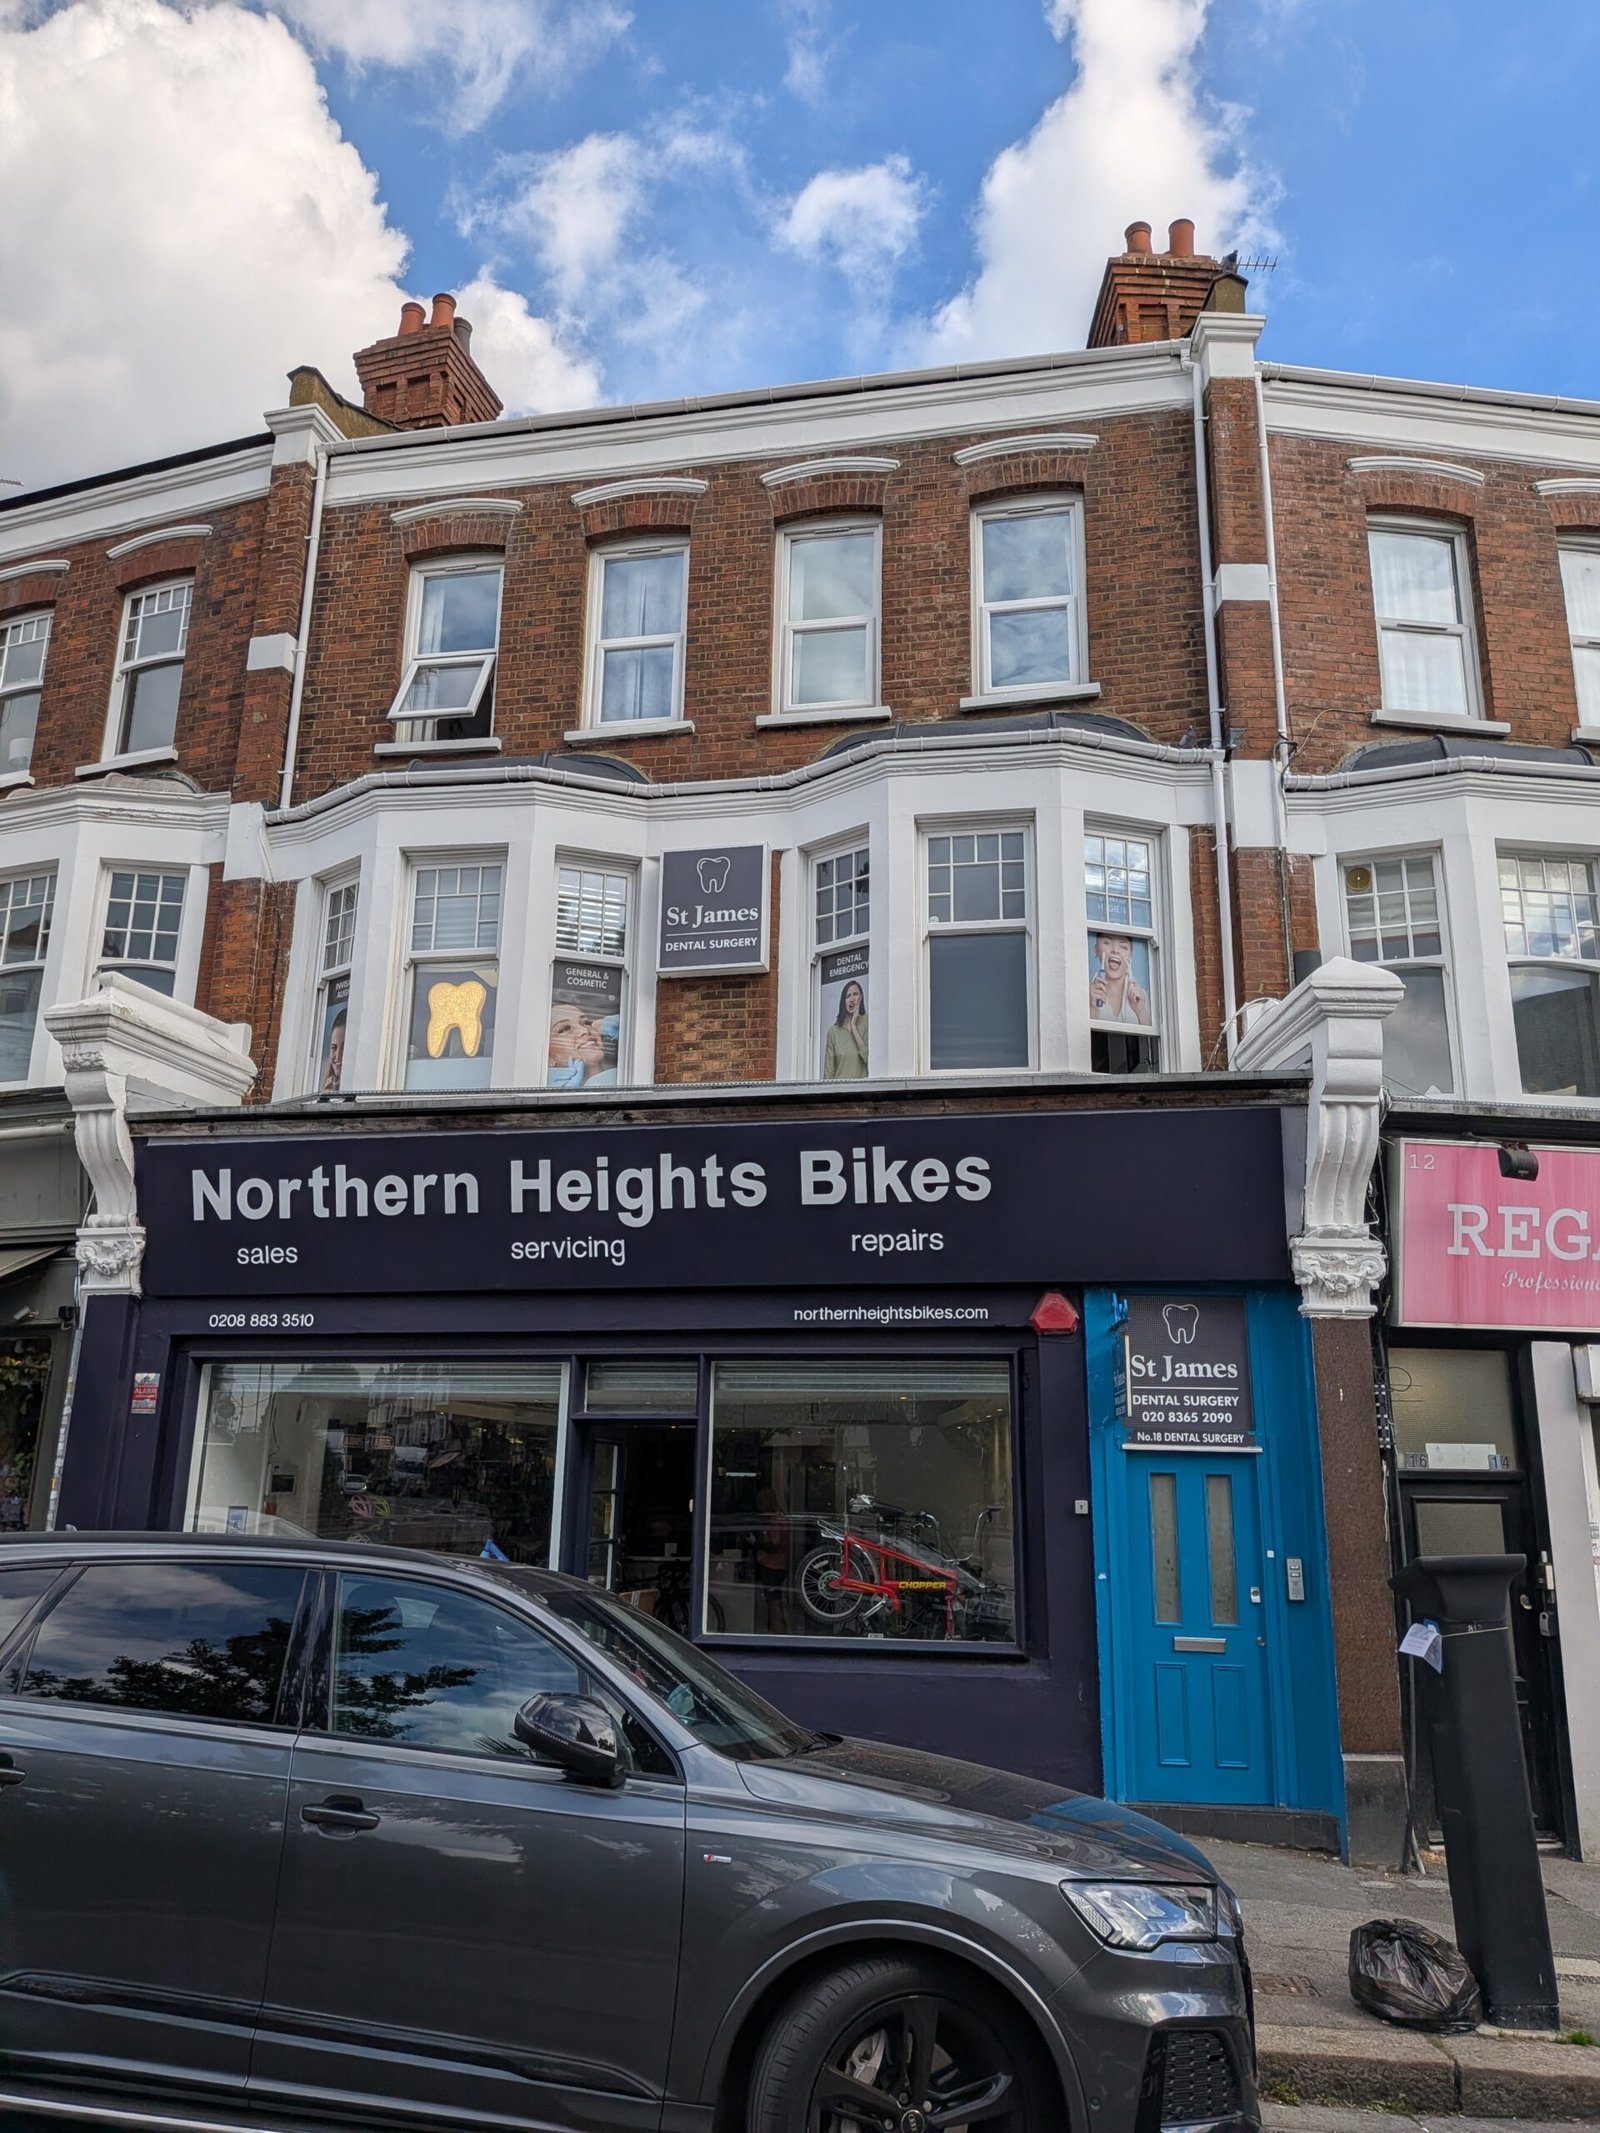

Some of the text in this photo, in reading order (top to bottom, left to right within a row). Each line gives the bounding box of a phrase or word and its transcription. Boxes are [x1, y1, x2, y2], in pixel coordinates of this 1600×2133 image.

[666, 905, 759, 928] St James
[665, 937, 758, 952] DENTAL SURGERY
[836, 953, 862, 966] DENTAL
[565, 967, 609, 980] GENERAL &
[829, 960, 869, 977] EMERGENCY
[567, 976, 608, 989] COSMETIC
[1408, 1154, 1436, 1170] 12
[191, 1146, 992, 1227] Northern Heights Bikes
[1447, 1203, 1600, 1261] REG
[851, 1229, 944, 1256] repairs
[236, 1244, 299, 1265] sales
[510, 1236, 626, 1267] servicing
[209, 1313, 314, 1327] 0208 883 3510
[794, 1306, 989, 1323] northernheightsbikes.com
[1131, 1354, 1238, 1382] St James
[1132, 1395, 1180, 1406] DENTAL
[1183, 1395, 1239, 1407] SURGERY
[1142, 1412, 1233, 1423] 020 8365 2090
[1137, 1432, 1244, 1444] No.18 DENTAL SURGERY
[1409, 1454, 1427, 1468] 16
[898, 1581, 947, 1589] CHOPPER
